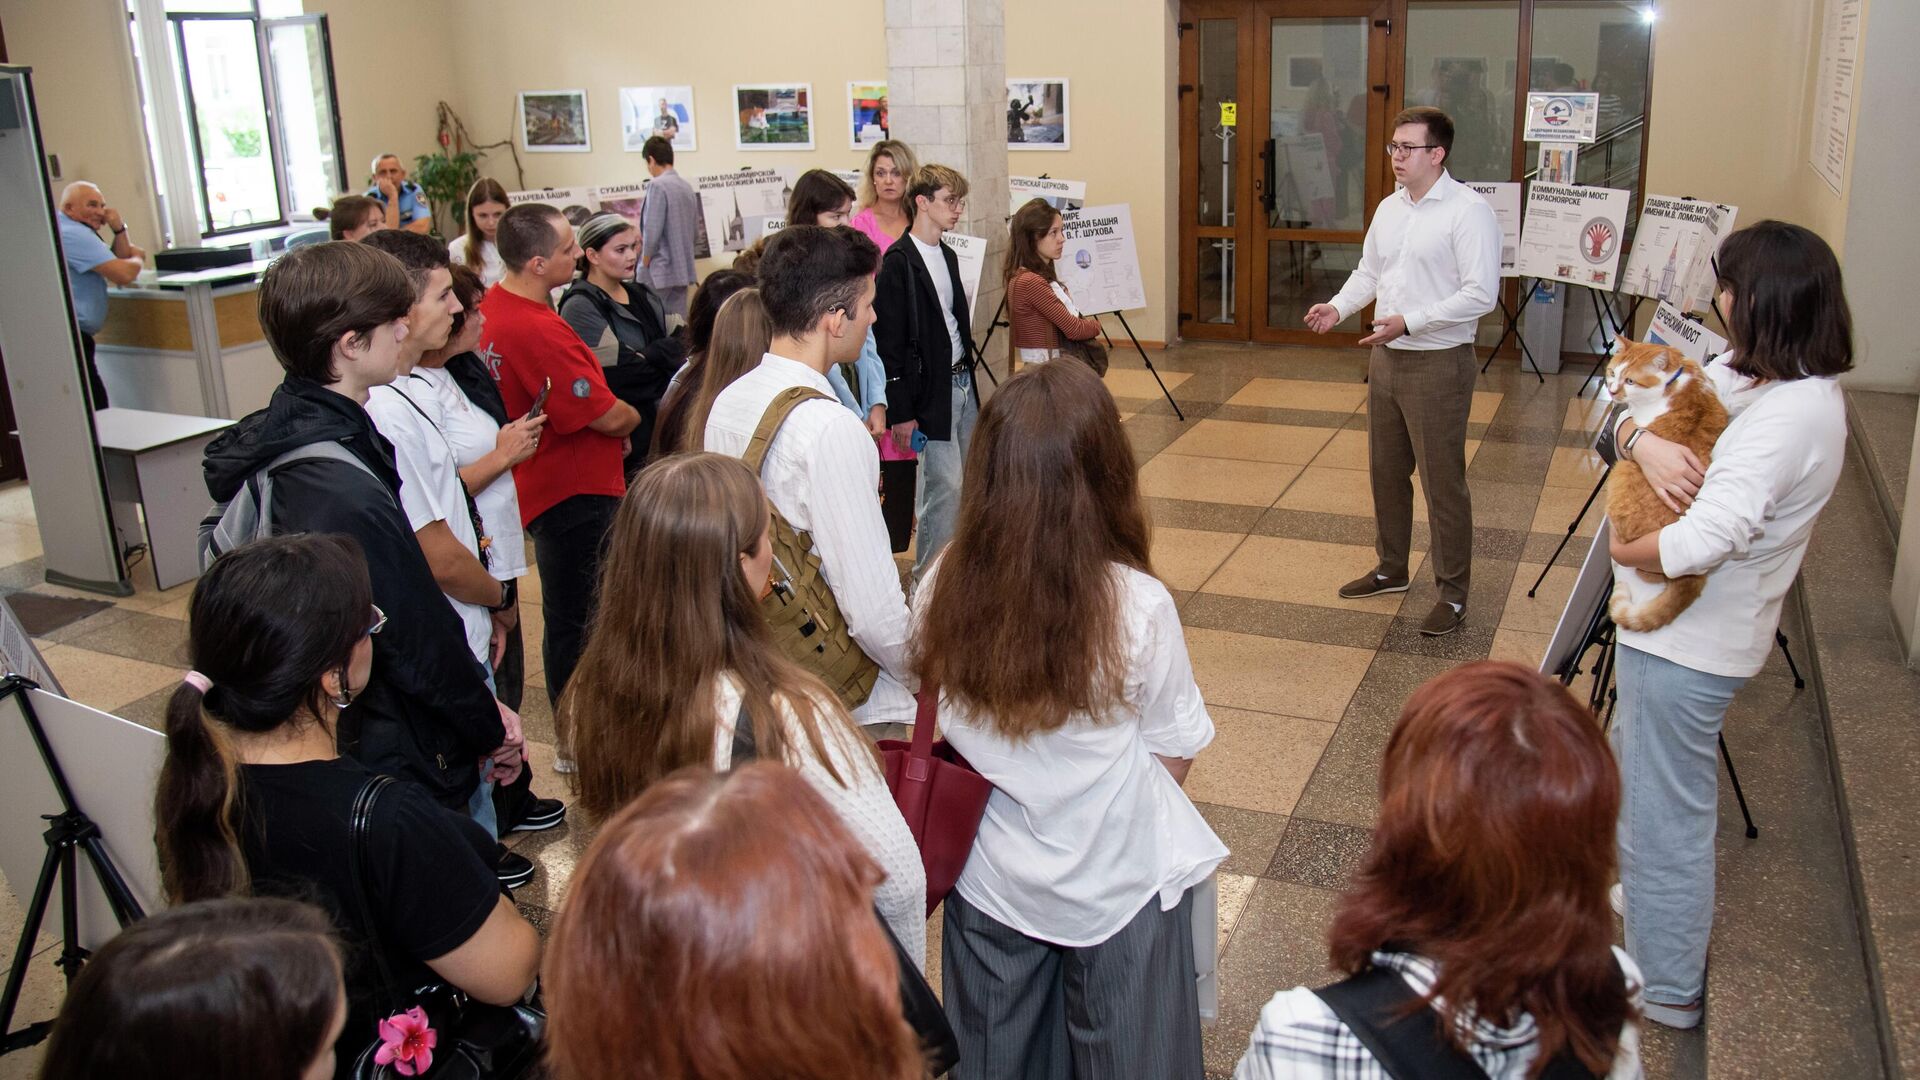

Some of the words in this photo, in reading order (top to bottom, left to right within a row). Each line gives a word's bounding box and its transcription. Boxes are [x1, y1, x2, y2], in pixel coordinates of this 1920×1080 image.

[720, 168, 776, 180] ВЛАДИМИРСКОЙ
[756, 176, 783, 185] МАТЕРИ
[1042, 181, 1070, 191] ЦЕРКОВЬ
[600, 184, 640, 195] СУХАРЕВА
[1532, 185, 1588, 199] КОММУНАЛЬНЫЙ
[1589, 190, 1609, 201] МОСТ
[1531, 192, 1536, 200] В
[1536, 193, 1581, 206] КРАСНОЯРСКЕ
[1644, 206, 1665, 217] ИМЕНИ
[1646, 198, 1672, 210] ГЛАВНОЕ
[1671, 202, 1695, 213] ЗДАНИЕ
[1695, 205, 1711, 216] МГУ
[1092, 216, 1119, 228] БАШНЯ
[1083, 226, 1114, 238] ШУХОВА
[956, 238, 969, 249] ГЭС
[1656, 306, 1684, 335] КЕРЧЕНСКИЙ
[1681, 323, 1702, 345] МОСТ
